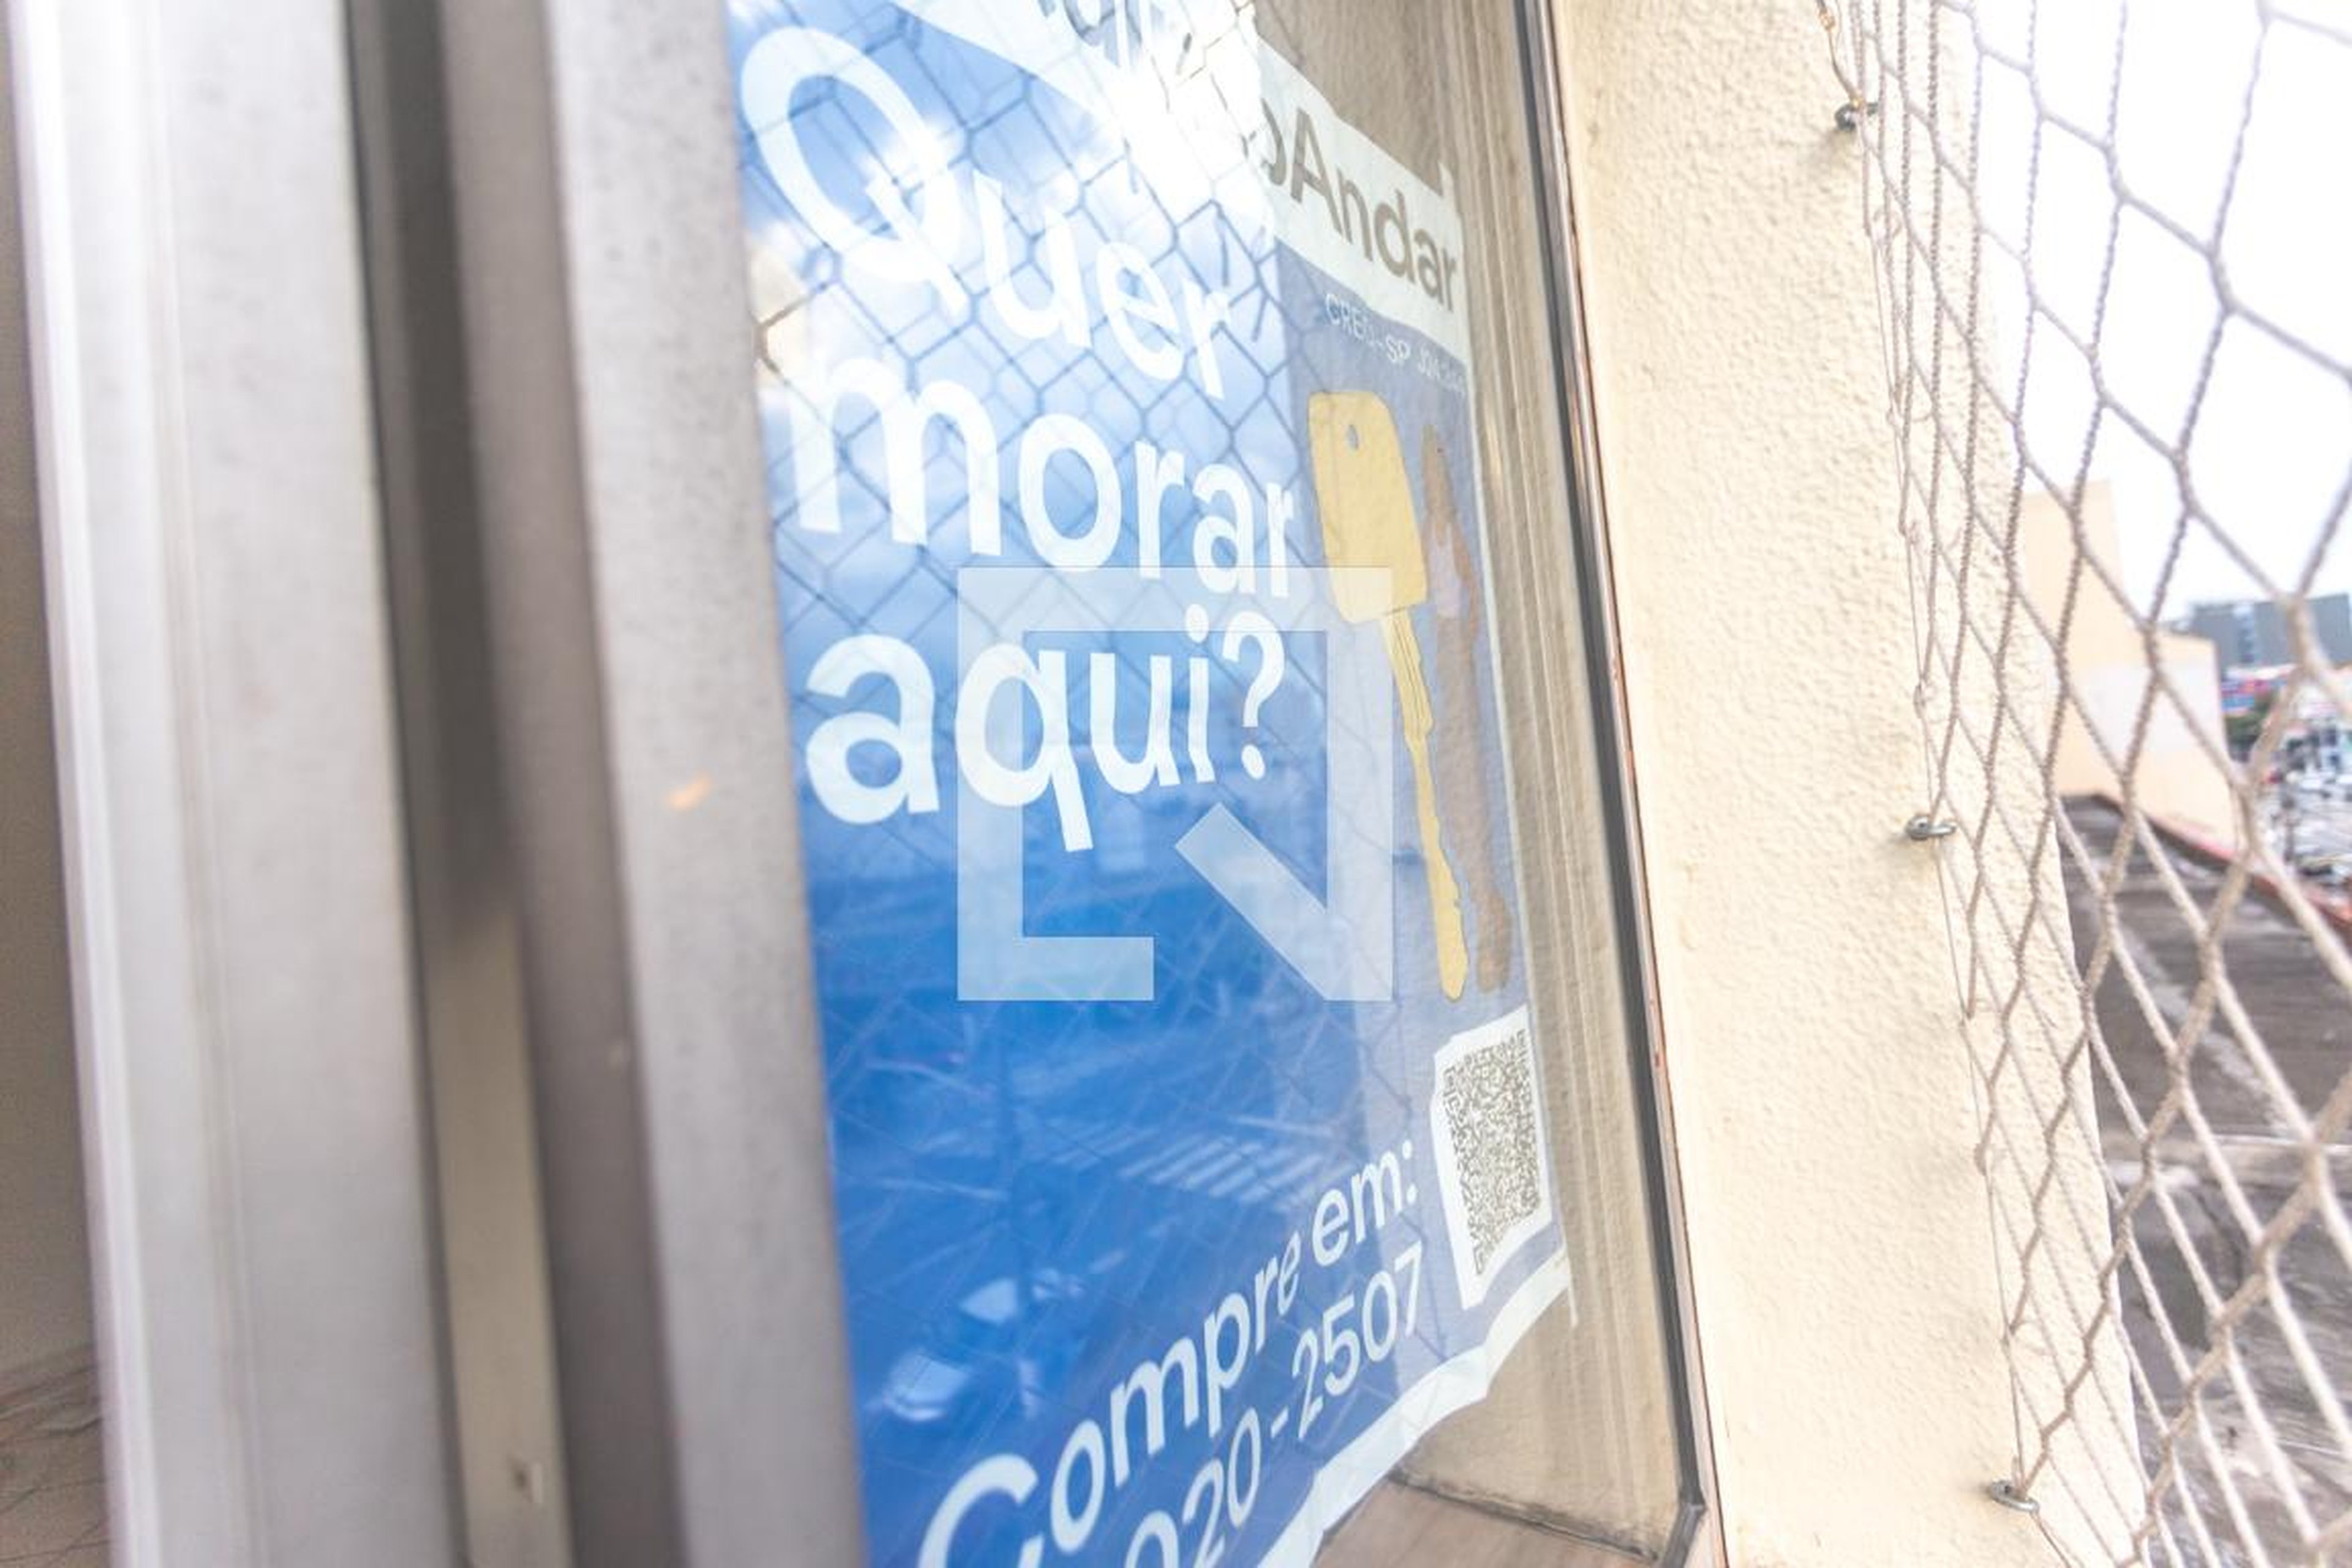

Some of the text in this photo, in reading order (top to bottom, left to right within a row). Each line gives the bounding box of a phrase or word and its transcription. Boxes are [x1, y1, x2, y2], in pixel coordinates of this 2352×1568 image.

[741, 26, 1232, 399] Quer
[787, 357, 1294, 598] morar
[805, 603, 1286, 852] aqui?
[918, 1139, 1417, 1568] Compre em:
